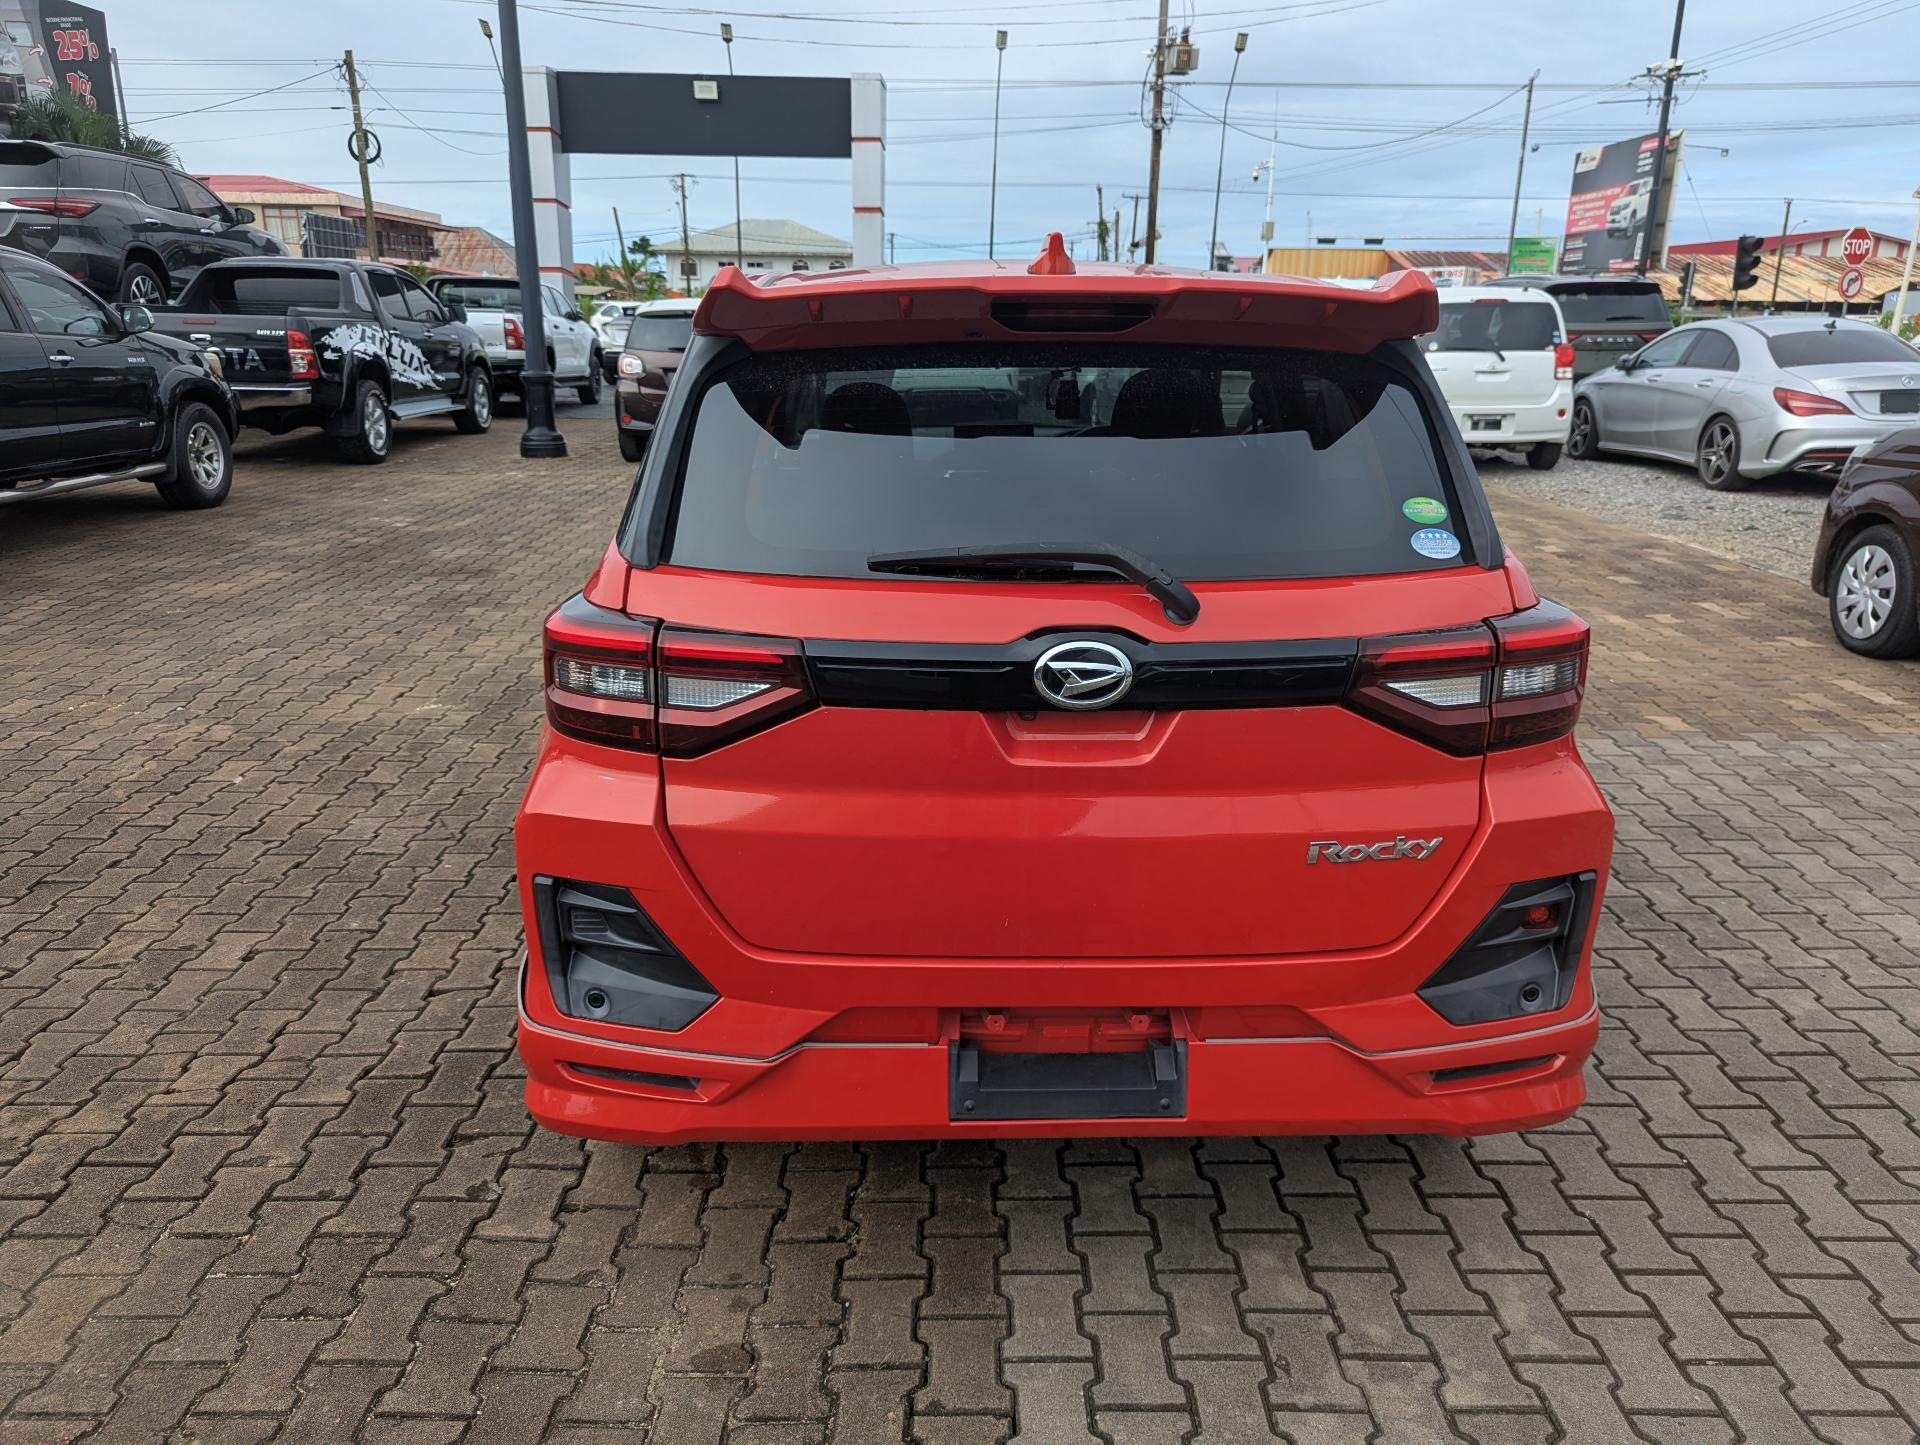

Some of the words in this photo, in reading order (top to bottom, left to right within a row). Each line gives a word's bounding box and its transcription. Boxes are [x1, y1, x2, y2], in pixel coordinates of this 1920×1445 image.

[53, 29, 99, 61] 25%
[1843, 239, 1871, 255] STOP
[1307, 835, 1444, 865] Rocky
